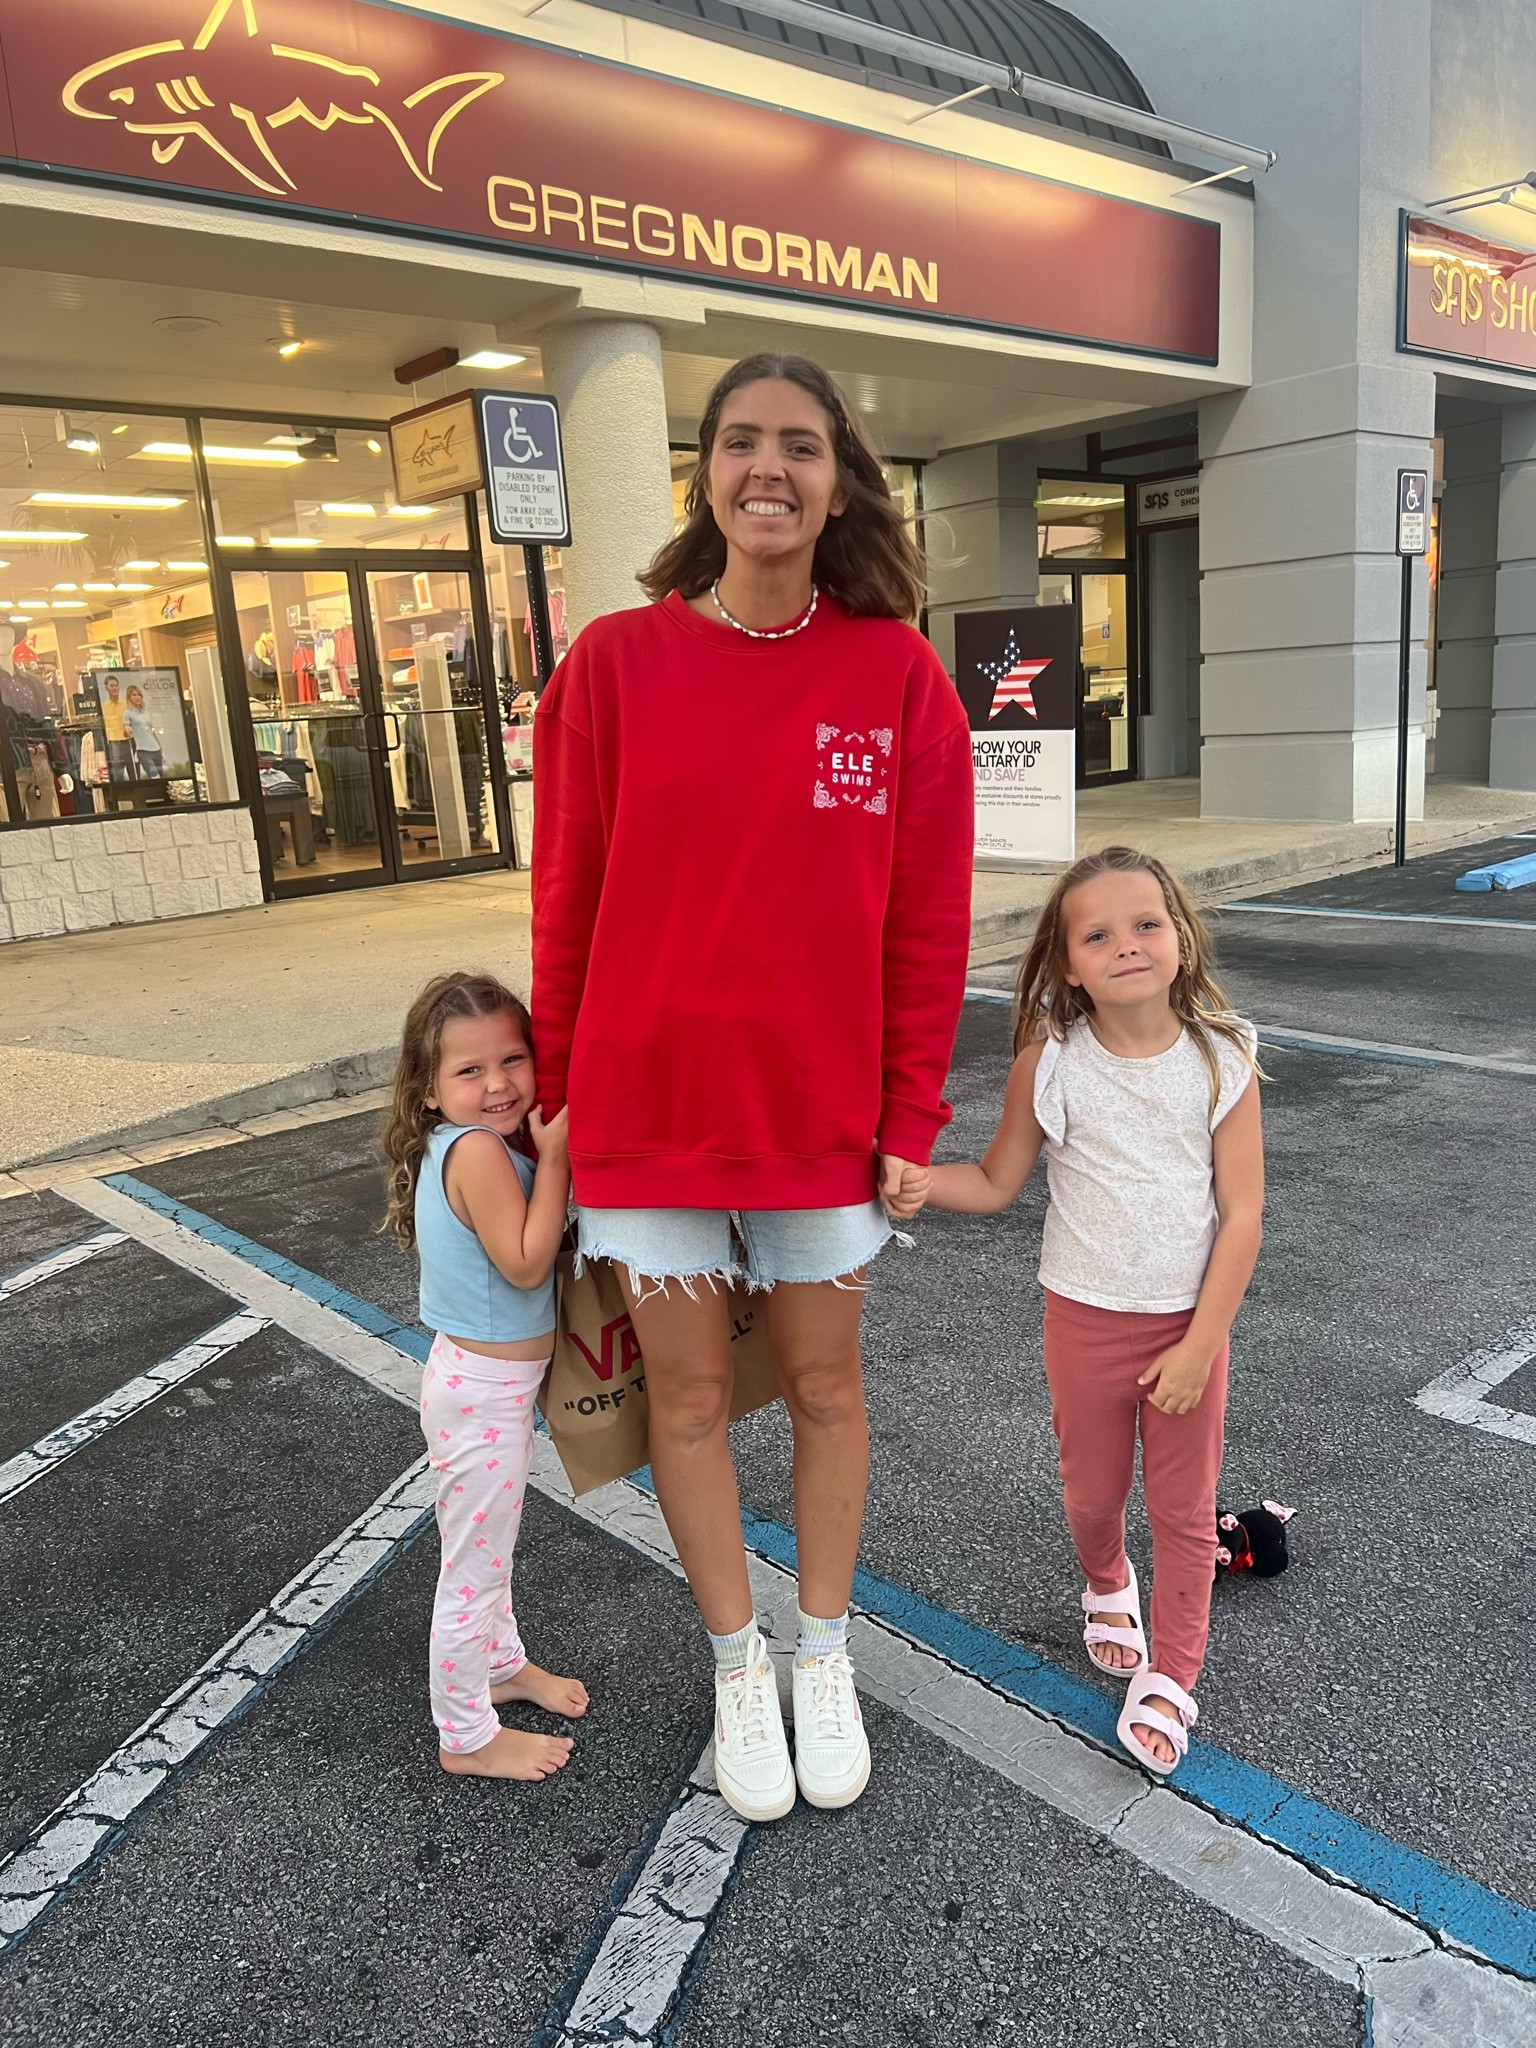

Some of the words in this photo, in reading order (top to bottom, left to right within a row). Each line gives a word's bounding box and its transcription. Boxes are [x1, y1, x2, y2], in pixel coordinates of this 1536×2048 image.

[1430, 258, 1483, 326] SAS
[507, 472, 535, 482] PARKING
[537, 474, 545, 482] BY
[499, 483, 530, 492] DISABLED
[533, 484, 555, 493] PERMIT
[1174, 487, 1199, 497] COMF
[520, 495, 537, 503] ONLY
[1144, 492, 1169, 509] SAS
[1180, 497, 1199, 506] SHO
[506, 506, 518, 514] TOW
[520, 507, 535, 515] AWAY
[504, 516, 509, 524] &
[544, 518, 558, 526] $250
[143, 682, 176, 690] COLOR
[972, 741, 1004, 754] HOW
[1007, 741, 1041, 754] YOUR
[832, 752, 874, 772] ELE
[1023, 755, 1035, 768] ID
[832, 773, 872, 786] SWIMS
[974, 769, 992, 780] ND
[994, 769, 1025, 781] SAVE
